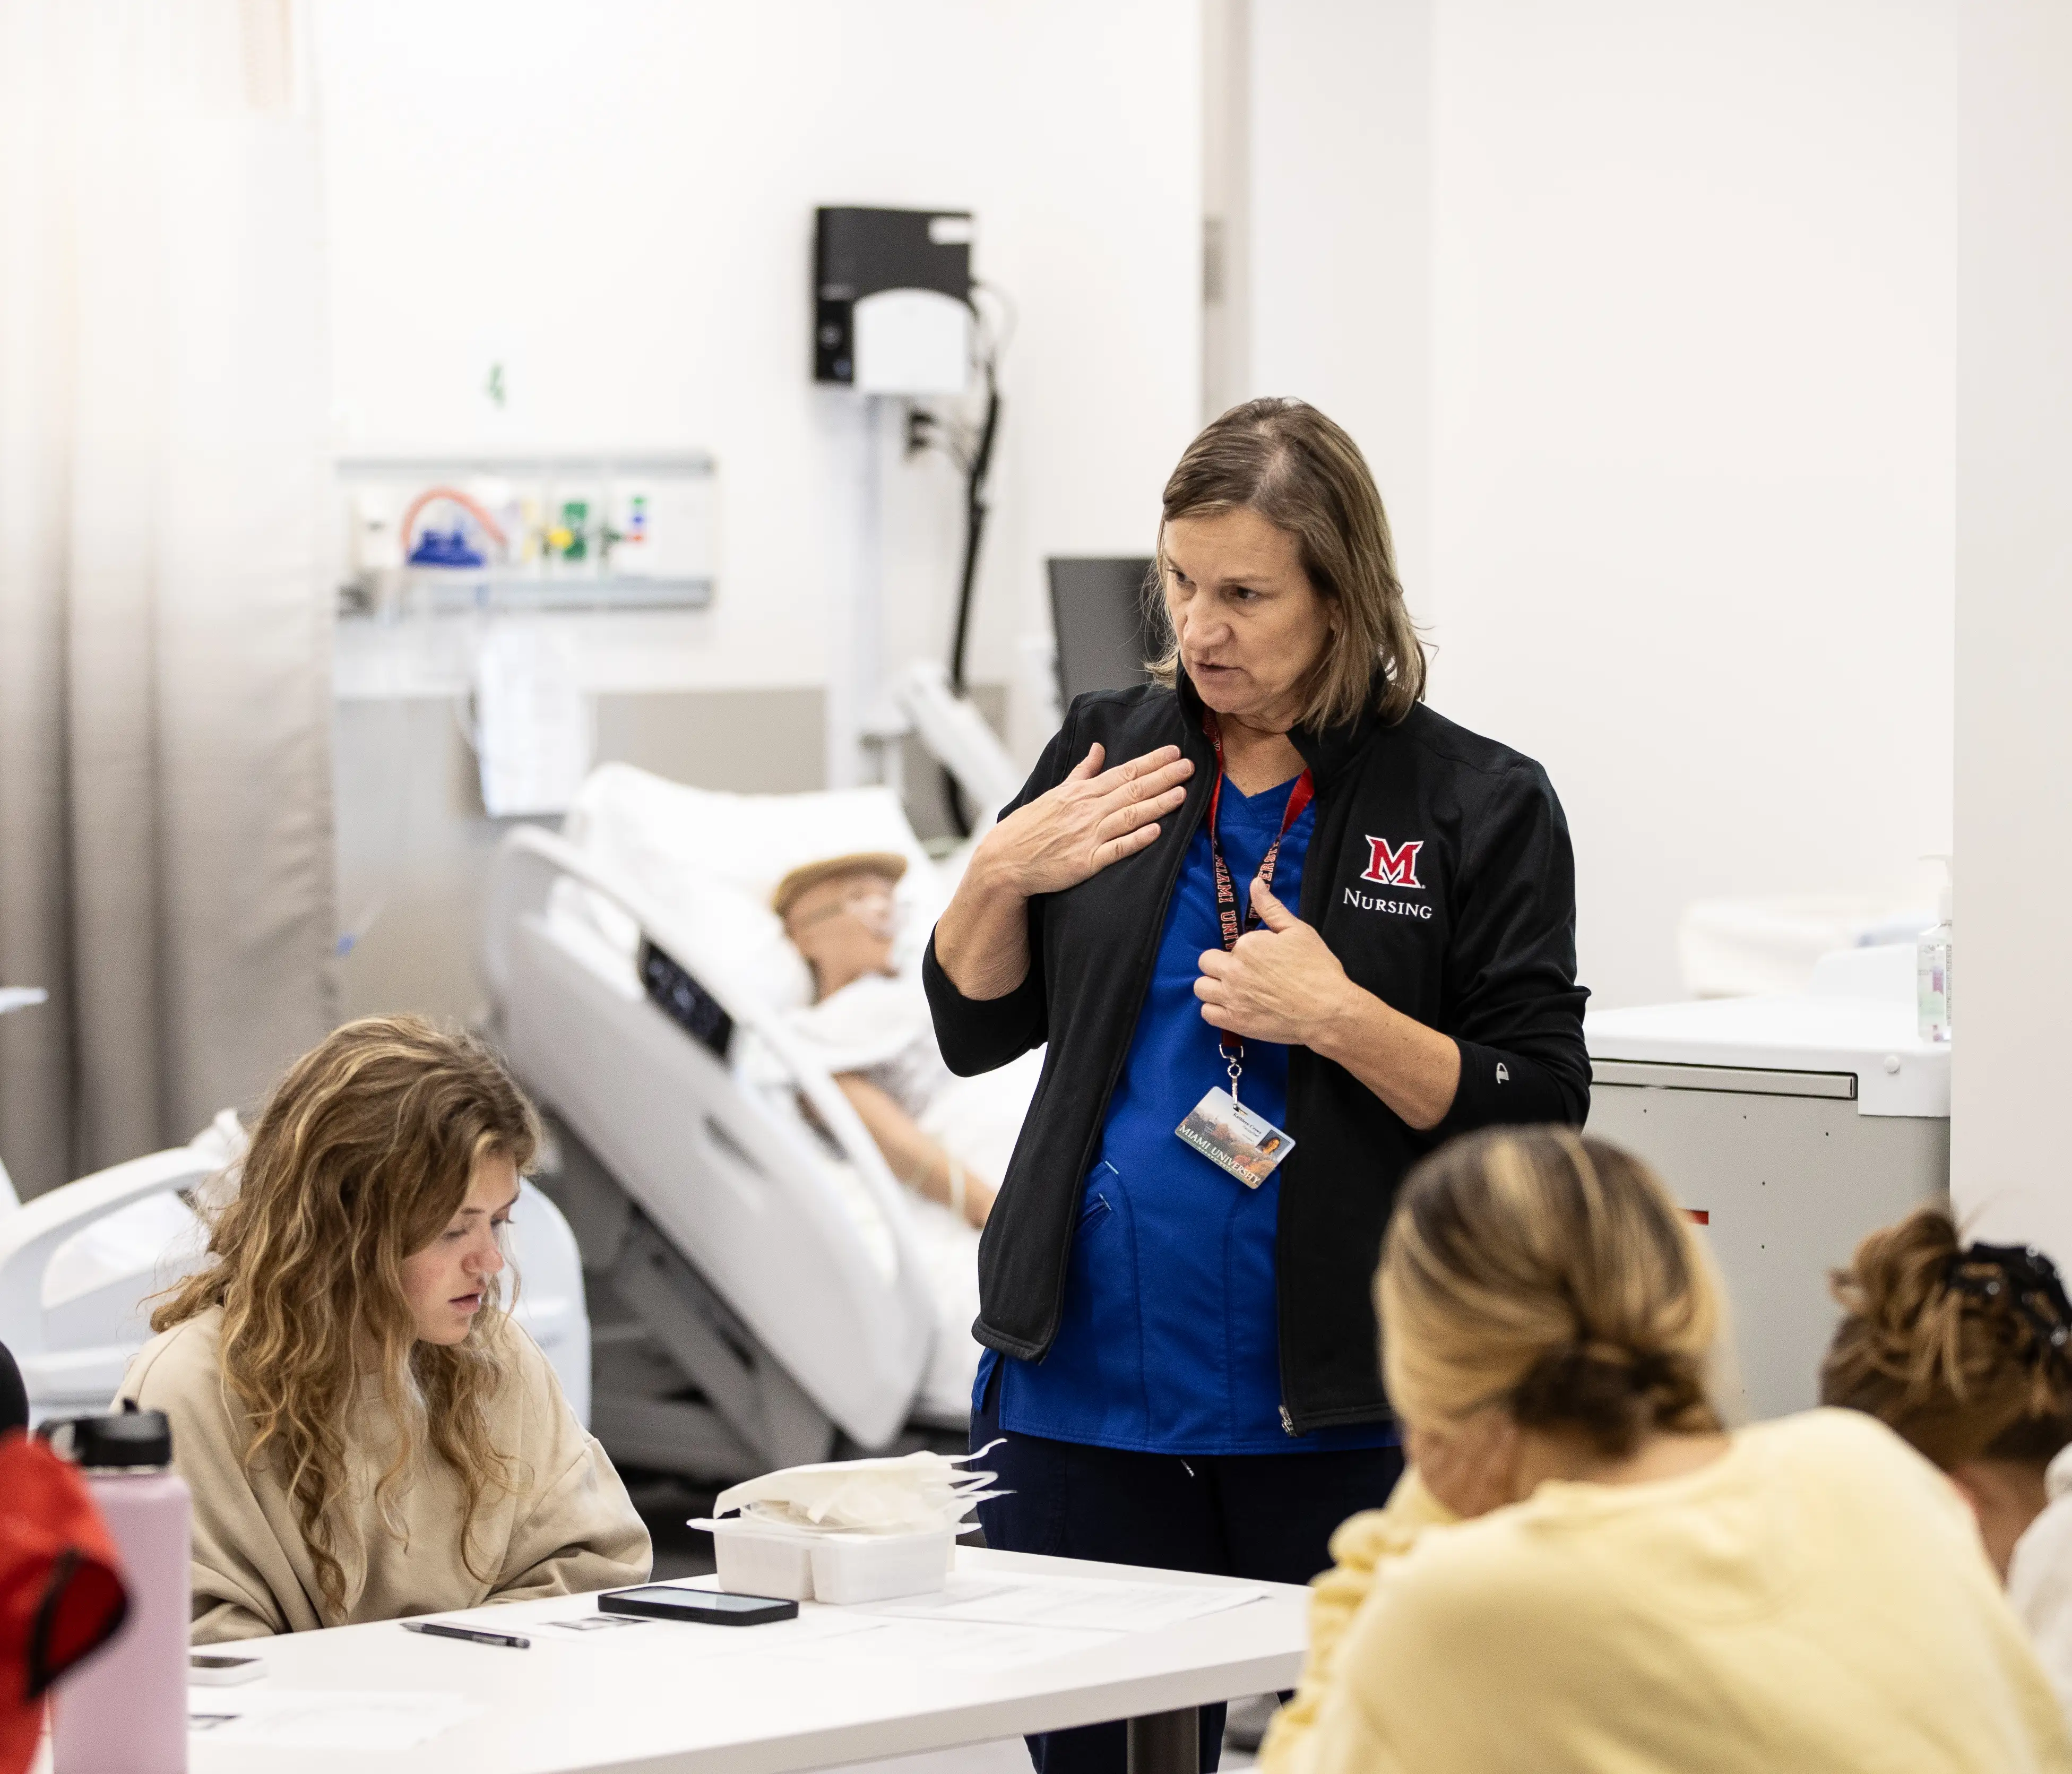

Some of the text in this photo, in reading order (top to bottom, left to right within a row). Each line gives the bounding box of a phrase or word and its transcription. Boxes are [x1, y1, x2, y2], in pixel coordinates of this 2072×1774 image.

[1215, 854, 1234, 903] MIAMI
[1360, 834, 1424, 889] M
[1343, 888, 1432, 919] NURSING
[1179, 1124, 1211, 1150] MIAMI
[1211, 1147, 1261, 1185] UNIVERSITY
